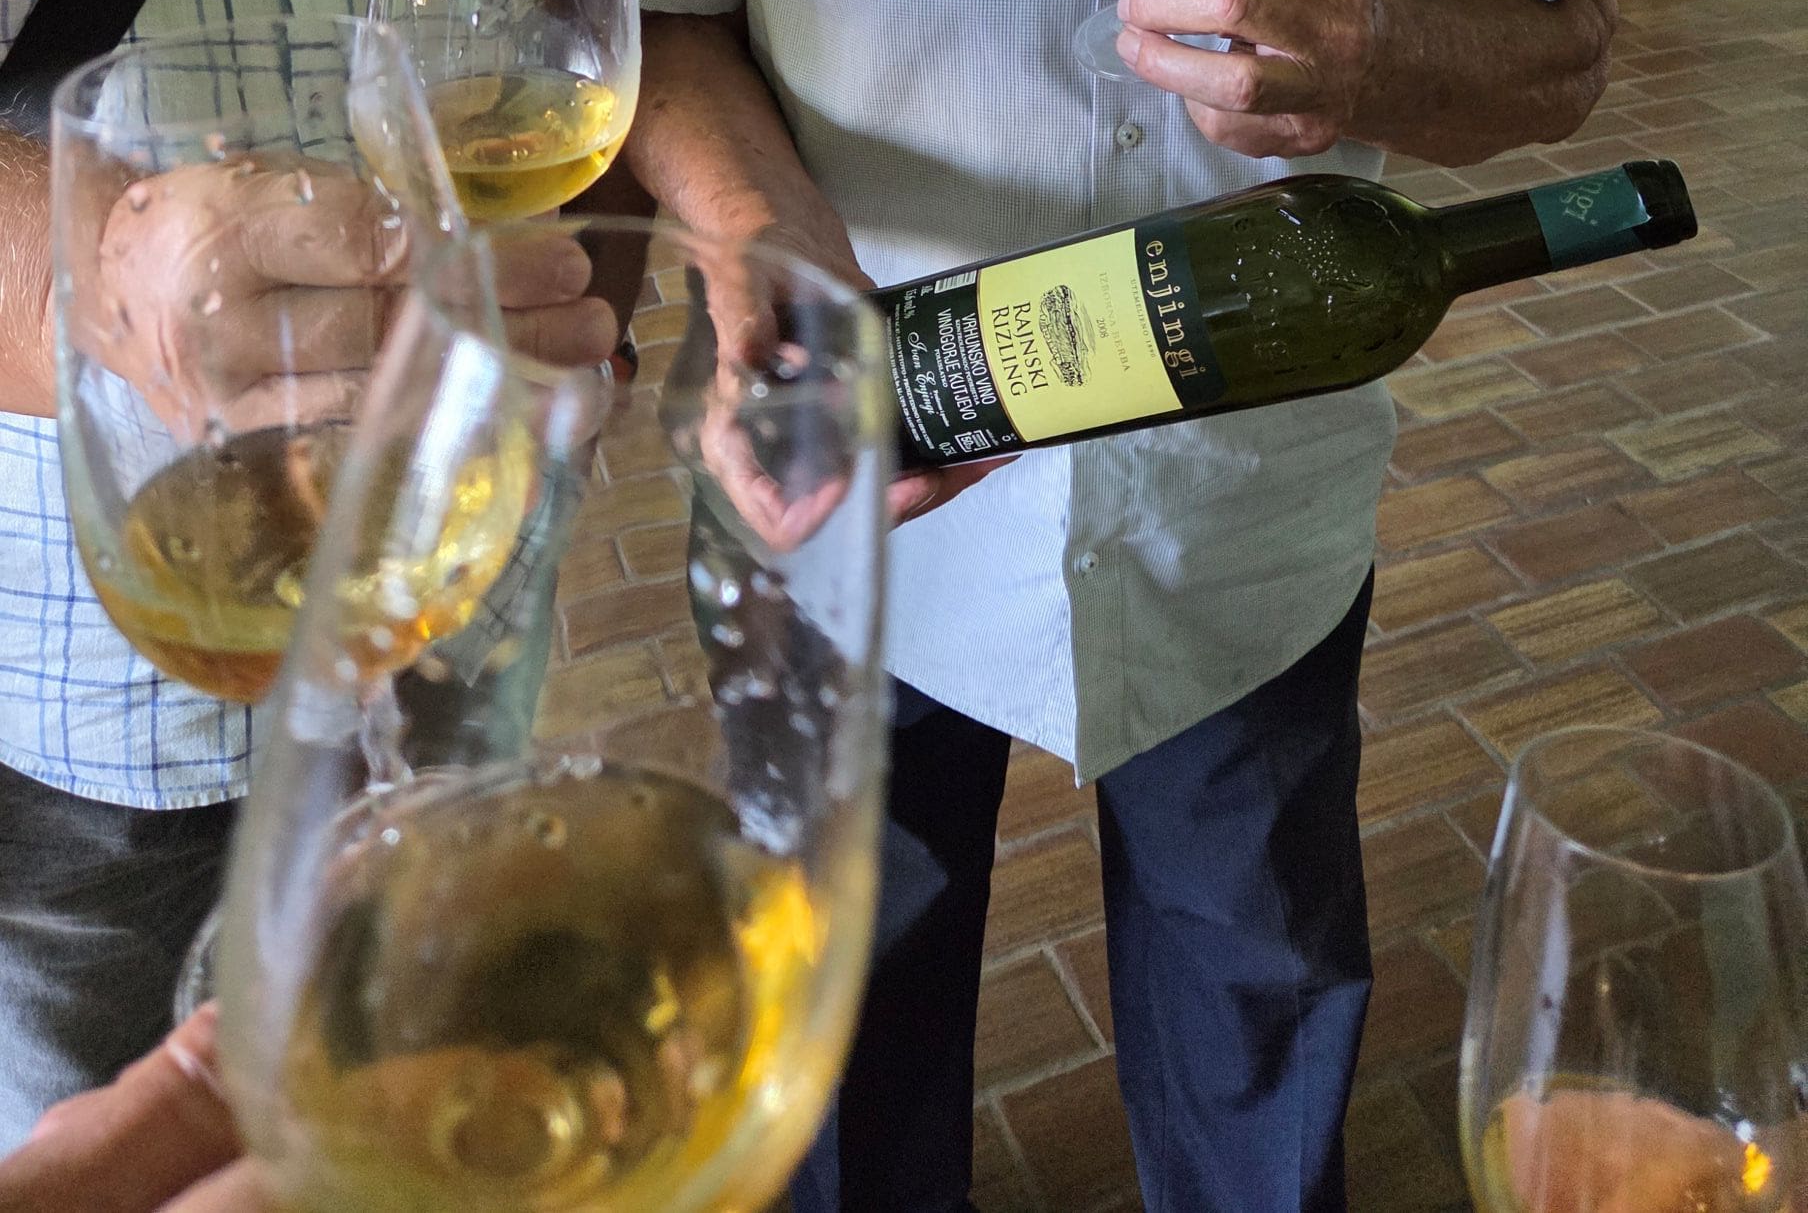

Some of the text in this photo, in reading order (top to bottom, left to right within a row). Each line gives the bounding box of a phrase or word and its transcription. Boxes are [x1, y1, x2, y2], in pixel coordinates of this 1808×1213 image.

[908, 331, 928, 369] Ivan
[992, 306, 1027, 396] RIZLING
[1013, 302, 1048, 389] RAJNSKI
[1096, 317, 1109, 339] 2008
[1100, 272, 1131, 372] IZBORNA BERBA
[1146, 240, 1206, 379] enjingi
[937, 308, 977, 420] VINOGORJE KUTJEVO
[962, 312, 988, 376] VRHUNSKO
[975, 376, 997, 405] VINO
